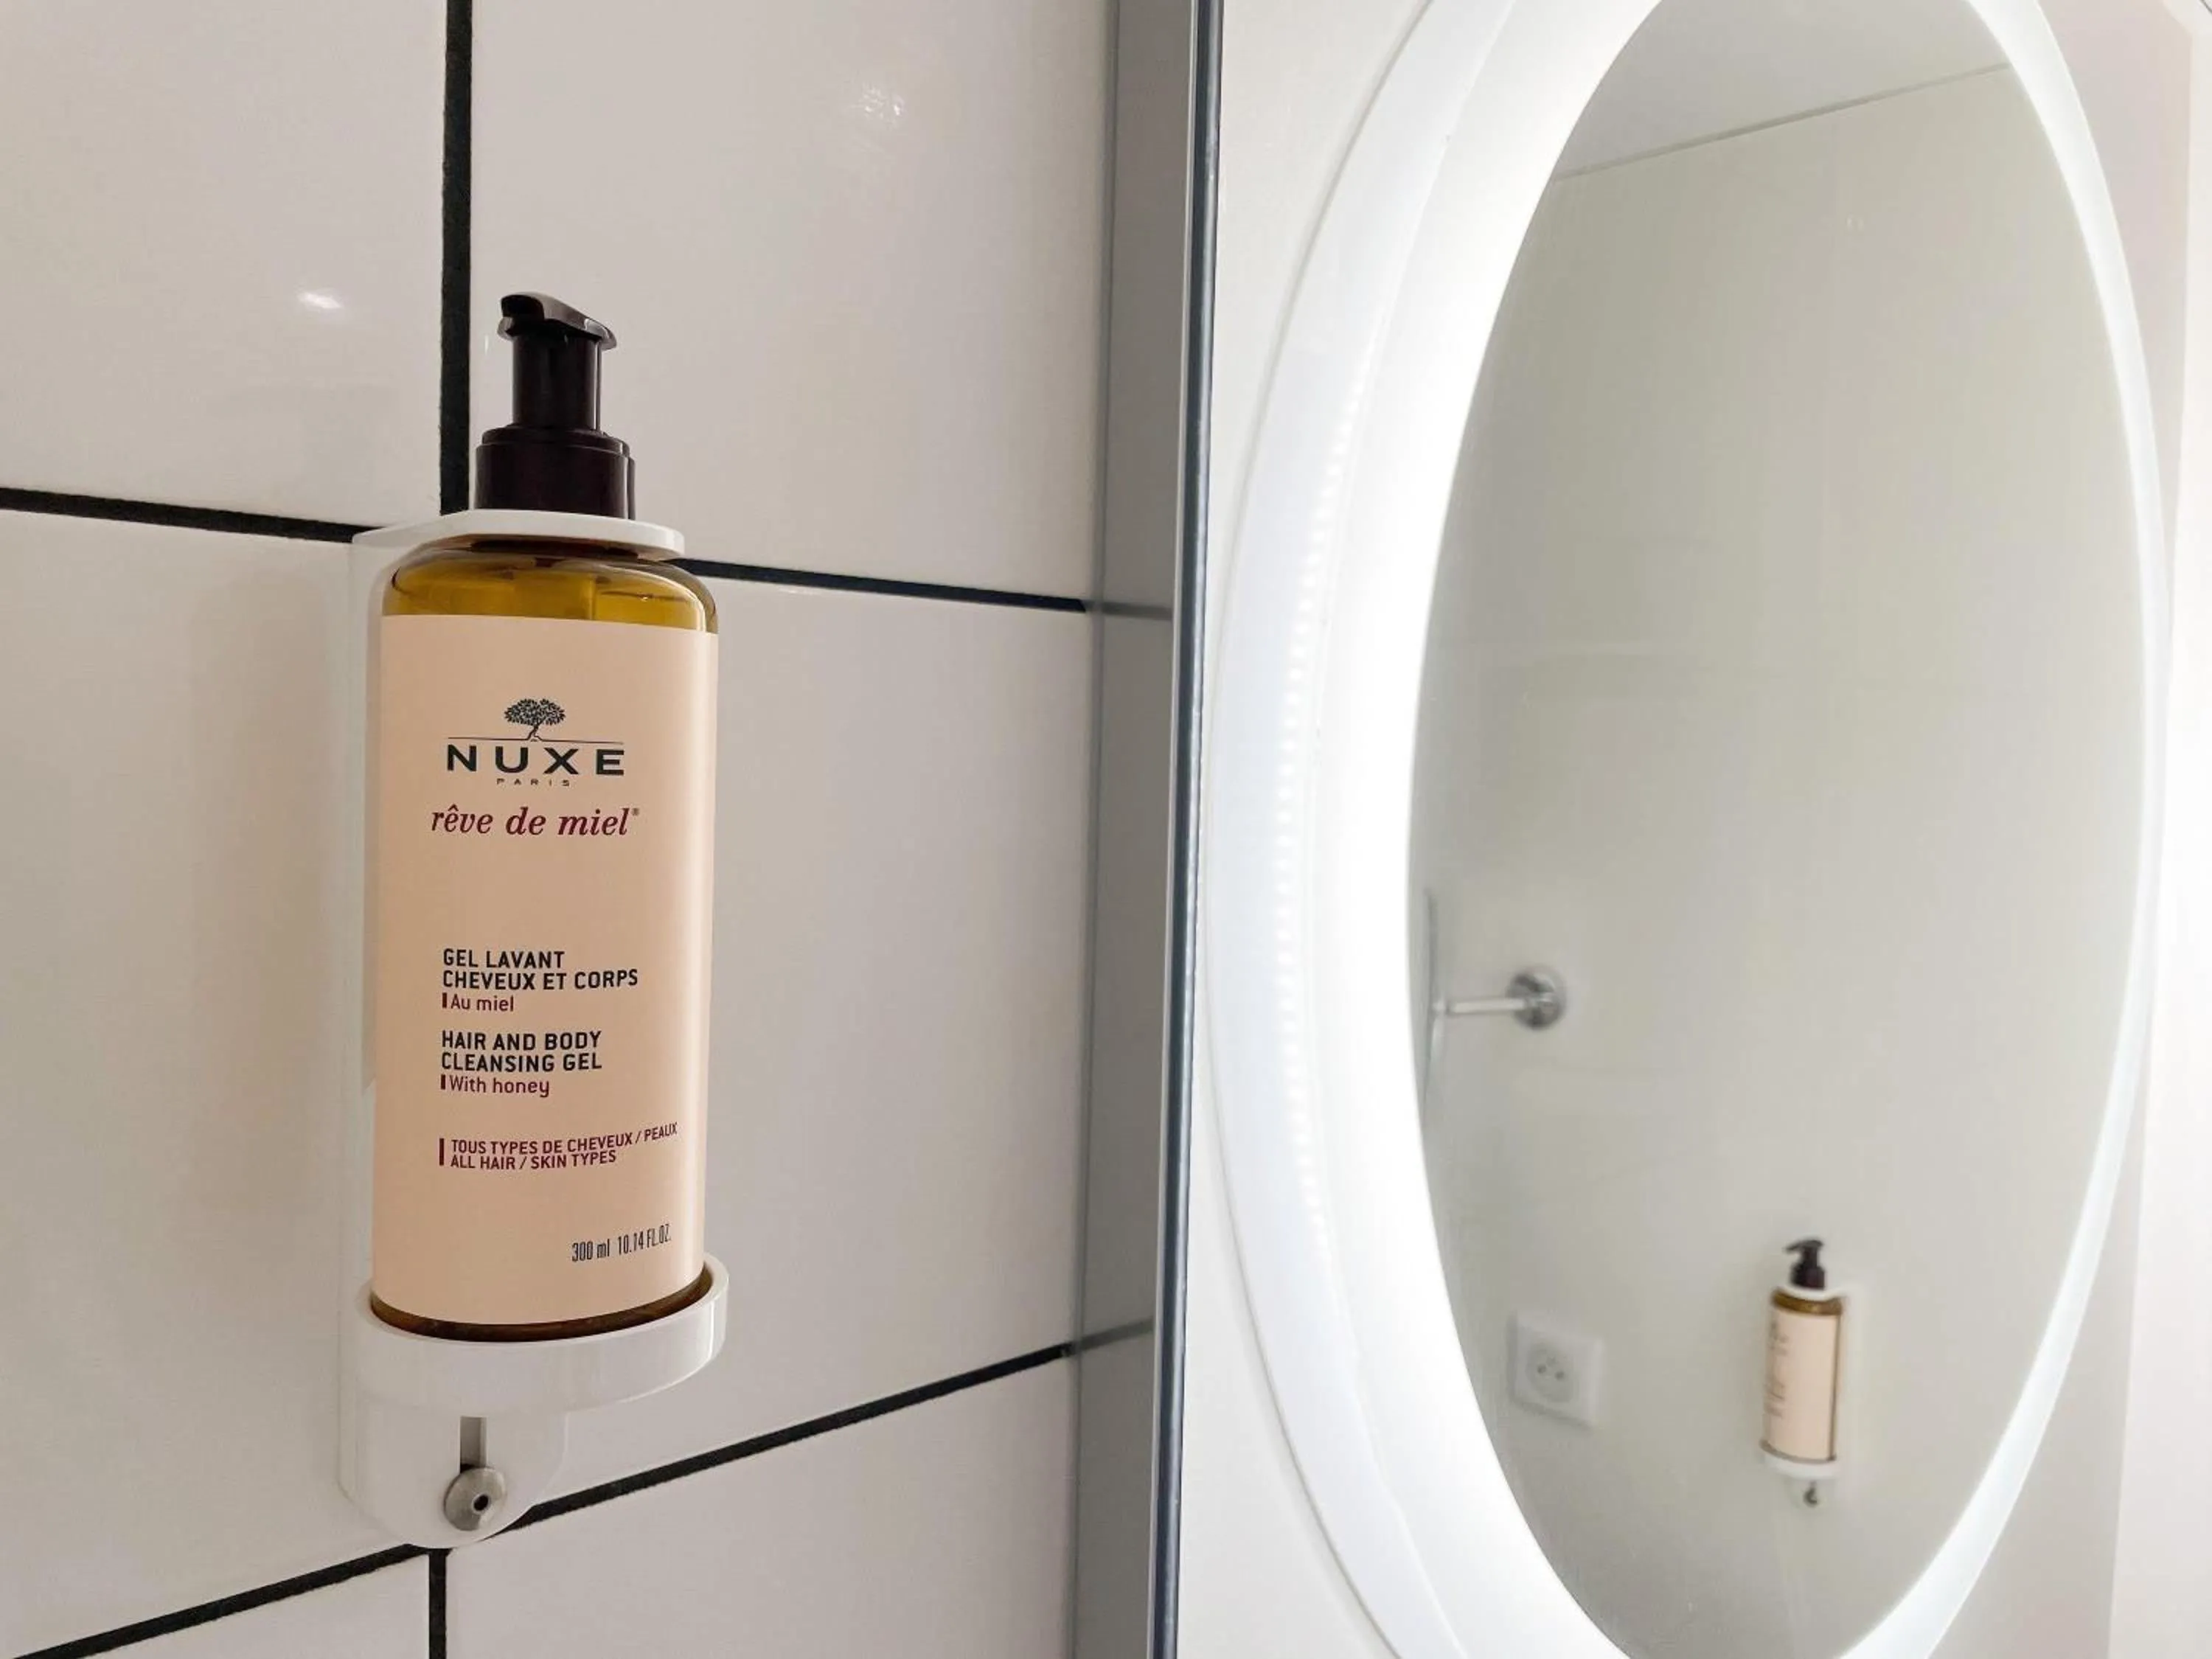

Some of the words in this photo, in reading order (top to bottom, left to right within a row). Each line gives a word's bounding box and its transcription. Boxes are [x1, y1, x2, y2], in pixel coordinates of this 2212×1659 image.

[447, 744, 625, 776] NUXE
[497, 778, 570, 787] PARIS
[431, 804, 493, 833] rêve
[506, 807, 546, 835] de
[443, 948, 478, 967] GEL
[486, 950, 565, 968] LAVANT
[442, 970, 535, 990] CHEVEUX
[543, 973, 567, 990] ET
[574, 969, 638, 990] CORPS
[451, 993, 470, 1010] Au
[476, 995, 514, 1012] miel
[442, 1030, 486, 1050] HAIR
[493, 1033, 536, 1051] AND
[545, 1031, 602, 1051] BODY
[442, 1052, 554, 1072] CLEANSING
[563, 1052, 602, 1071] GEL
[450, 1075, 486, 1093] With
[493, 1078, 550, 1097] honey
[451, 1139, 486, 1154] TOUS
[493, 1141, 538, 1155] TYPES
[543, 1140, 563, 1154] DE
[567, 1132, 633, 1152] CHEVEUX
[644, 1121, 678, 1142] PEAUX
[451, 1155, 476, 1169] ALL
[481, 1155, 515, 1170] HAIR
[530, 1155, 566, 1169] SKIN
[572, 1149, 616, 1167] TYPES
[571, 1242, 594, 1263] 300
[597, 1238, 611, 1259] ml
[617, 1231, 644, 1256] 10.14
